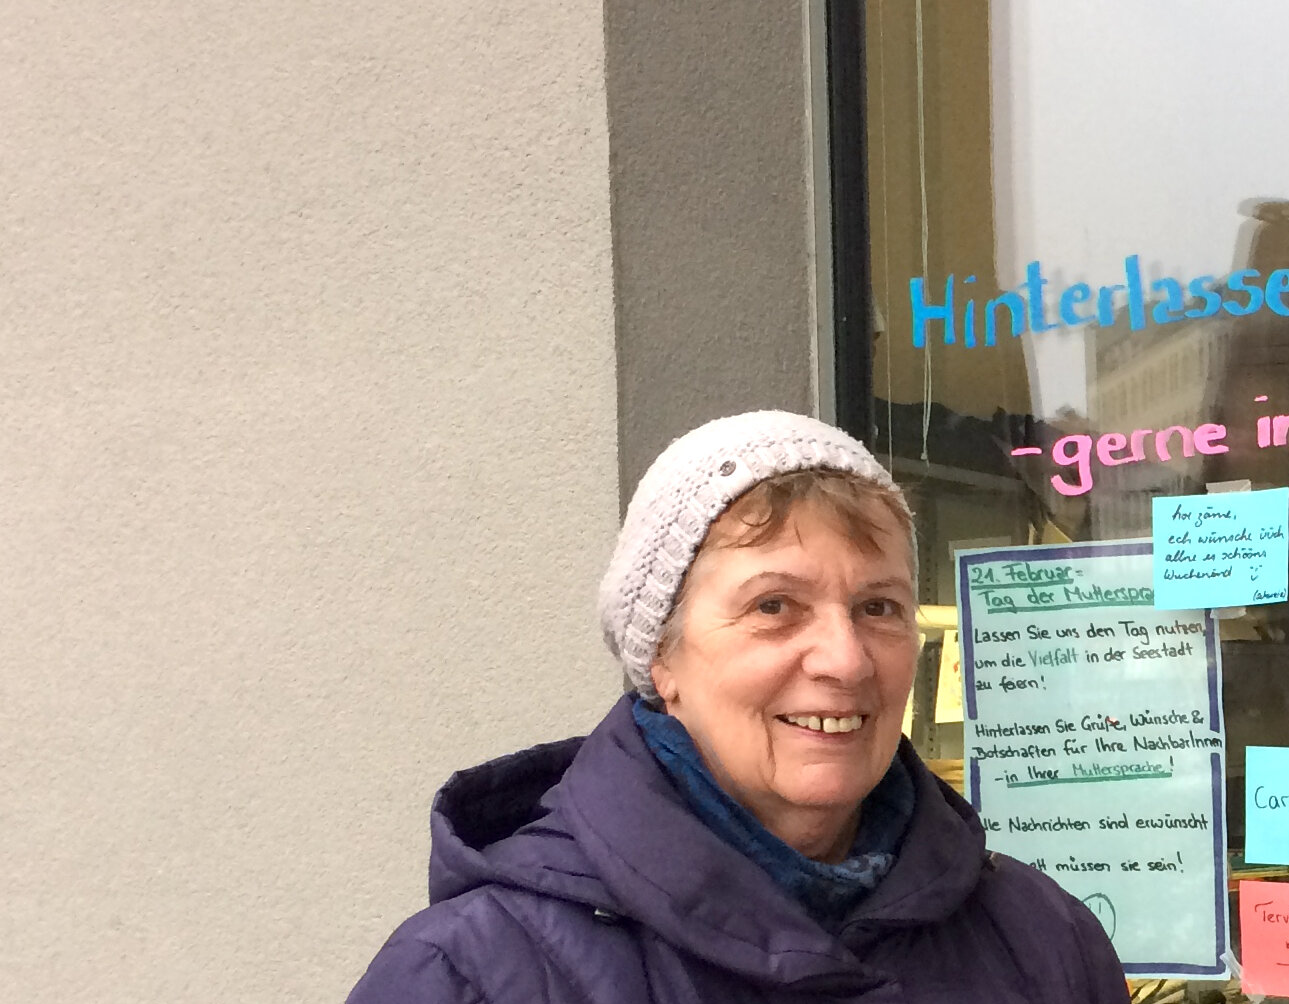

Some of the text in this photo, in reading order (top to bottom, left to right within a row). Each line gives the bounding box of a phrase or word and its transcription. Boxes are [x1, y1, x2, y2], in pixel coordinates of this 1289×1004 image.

[971, 567, 1000, 584] 21.
[978, 584, 1155, 612] Tag der Mutterspra
[974, 628, 1021, 644] Lassen
[1026, 624, 1051, 640] Sie
[1056, 627, 1080, 639] uns
[1086, 622, 1115, 639] den
[1118, 620, 1150, 645] Tag
[975, 641, 1193, 669] um die Vielfalt in der Seestadt
[976, 679, 992, 691] zu
[975, 722, 1050, 738] Hinterlassen
[1055, 718, 1077, 733] Sie
[1130, 710, 1189, 726] Wünsche
[1192, 710, 1204, 724] &
[972, 744, 1057, 760] Botschaften
[1063, 738, 1088, 756] für
[1095, 736, 1127, 753] Ihre
[1027, 765, 1059, 780] Ihrer
[982, 812, 1209, 833] lle Nachrichten sind erwünscht
[1055, 855, 1111, 872] müssen
[1120, 859, 1141, 872] sie
[1148, 851, 1185, 874] sein!
